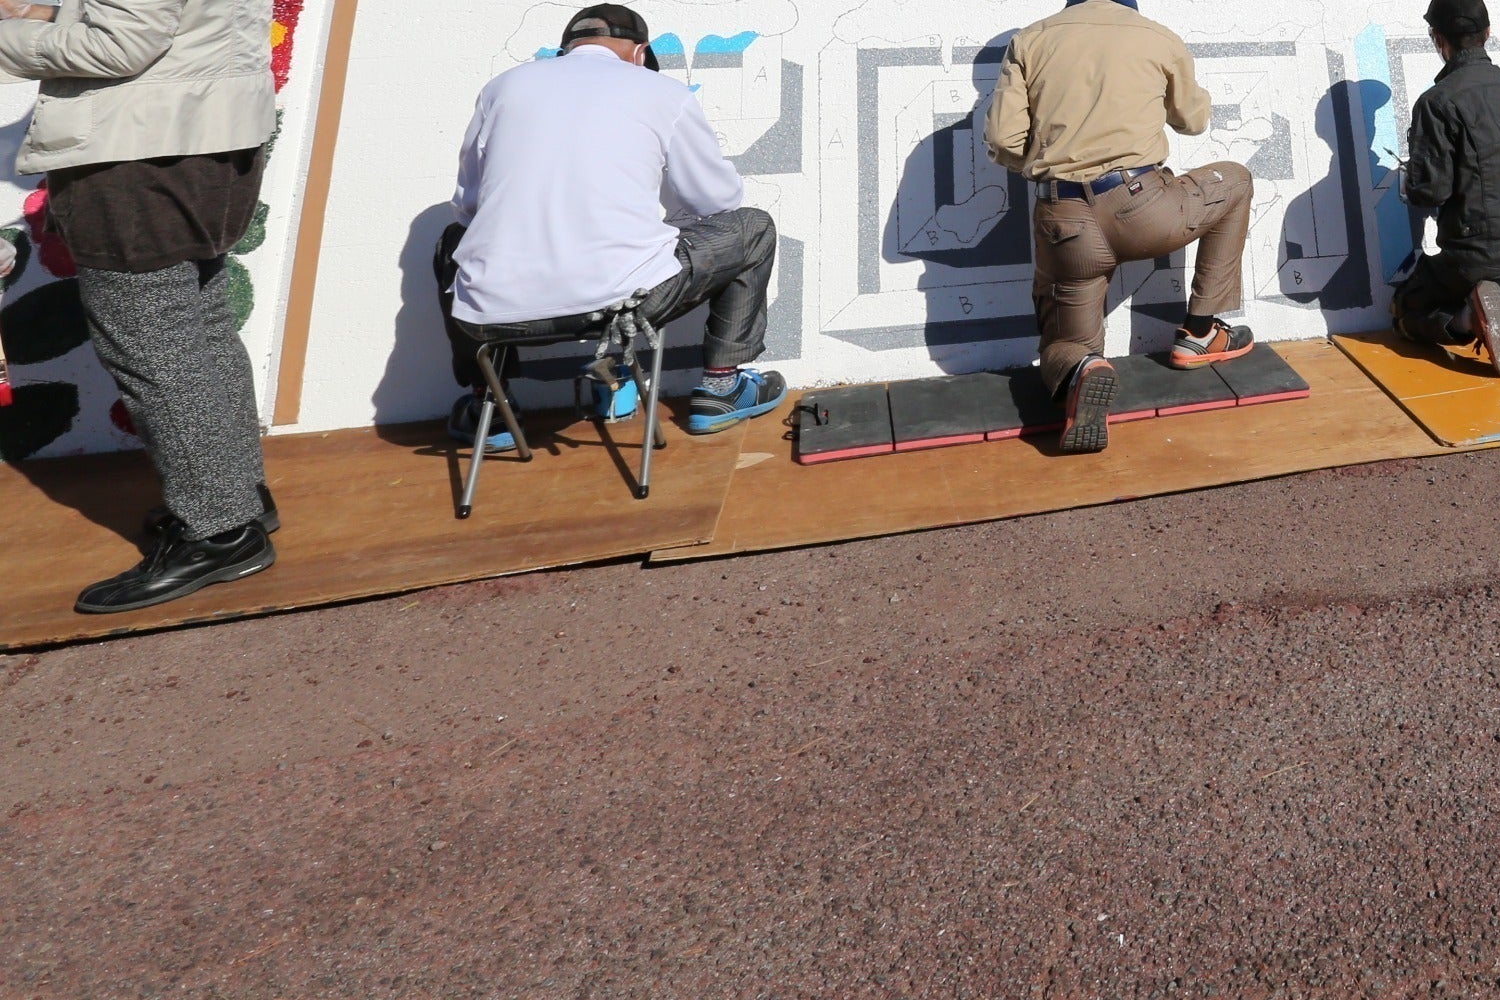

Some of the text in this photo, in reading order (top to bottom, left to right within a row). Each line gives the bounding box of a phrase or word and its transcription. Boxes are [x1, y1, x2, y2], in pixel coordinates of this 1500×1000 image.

[754, 66, 767, 82] A
[950, 89, 961, 102] B
[1224, 84, 1233, 95] B
[827, 128, 844, 149] A
[909, 130, 923, 145] A
[926, 231, 938, 245] B
[1263, 232, 1274, 250] A
[1294, 271, 1302, 284] B
[959, 296, 973, 314] B
